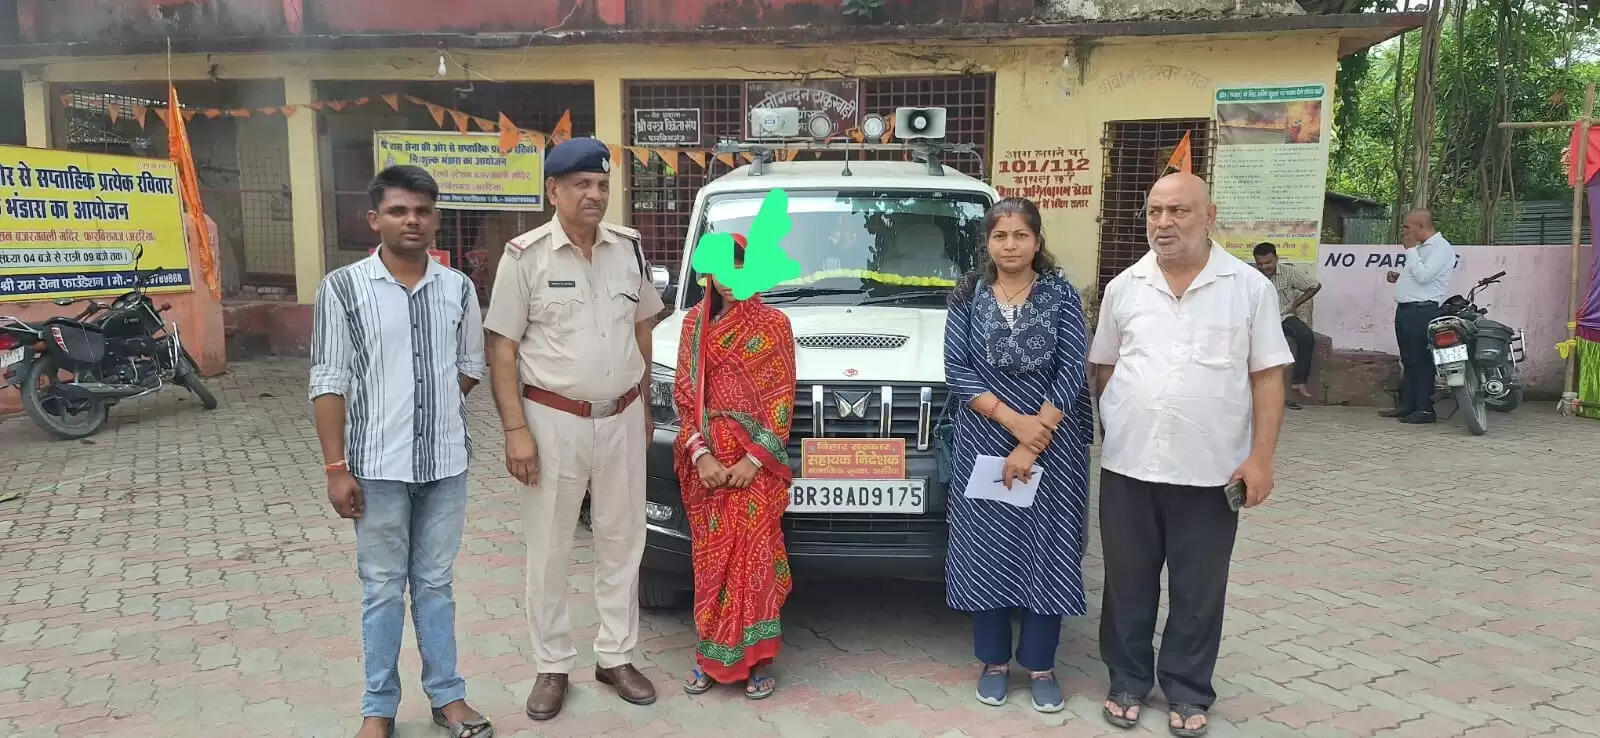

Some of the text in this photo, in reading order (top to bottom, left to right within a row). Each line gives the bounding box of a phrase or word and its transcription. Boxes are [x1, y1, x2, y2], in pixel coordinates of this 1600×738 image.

[638, 118, 646, 132] श्री
[647, 121, 663, 131] वस्त्र
[685, 118, 697, 131] संघ
[421, 141, 430, 152] की
[433, 141, 447, 152] ओर
[449, 142, 455, 152] से
[1005, 151, 1032, 159] आग
[1068, 148, 1086, 158] पर
[463, 157, 472, 165] का
[475, 155, 507, 166] आयोजन
[999, 158, 1090, 174] 101/112
[17, 161, 31, 187] से
[35, 165, 95, 190] सप्ताहिक
[98, 168, 133, 192] प्रत्येक
[136, 171, 174, 194] रविवार
[1012, 172, 1076, 185] डायल करें
[1072, 184, 1093, 195] सेवा
[6, 192, 129, 220] भंडारा का आयोजन
[24, 254, 35, 263] 04
[38, 251, 51, 262] बजे
[54, 251, 61, 262] से
[84, 253, 93, 261] 09
[96, 251, 108, 261] बजे
[1325, 253, 1356, 267] NO
[1, 277, 15, 291] श्री
[17, 280, 36, 291] राम
[38, 277, 60, 290] सेना
[816, 442, 848, 451] बिहार
[808, 450, 900, 466] सहायक निदेशक
[793, 486, 922, 506] BR38AD9175
